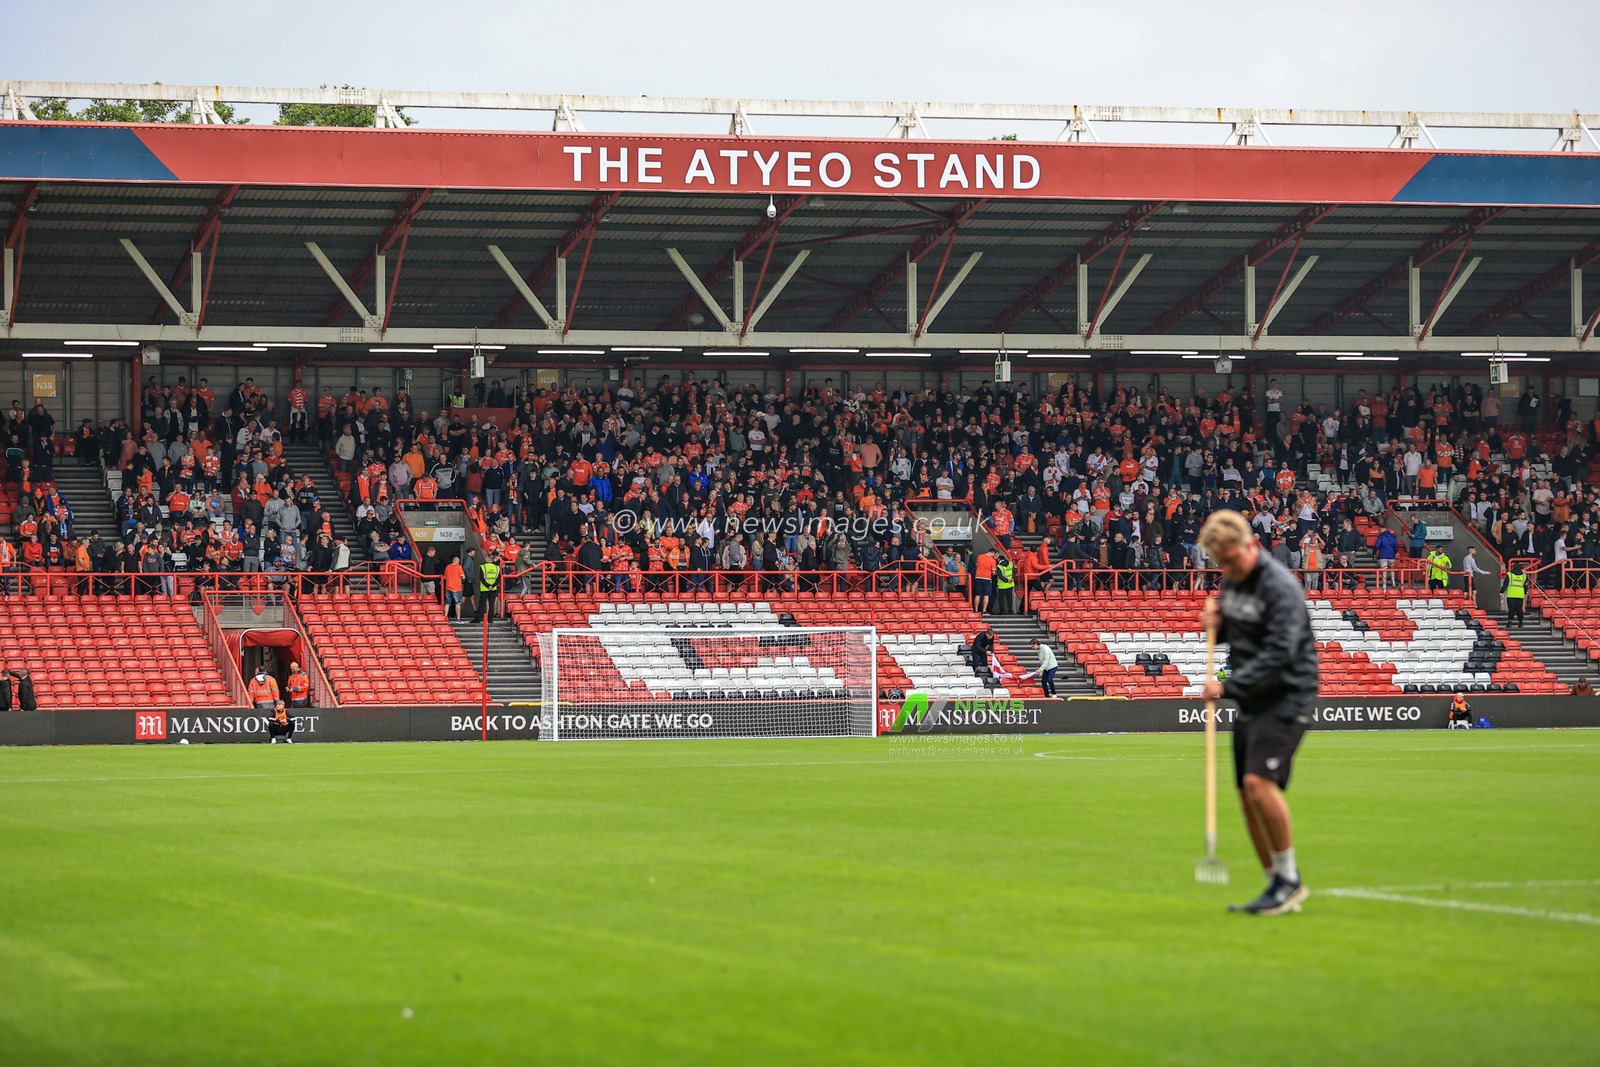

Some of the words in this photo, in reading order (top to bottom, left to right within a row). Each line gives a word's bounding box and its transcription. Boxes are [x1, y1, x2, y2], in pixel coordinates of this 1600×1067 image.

[562, 145, 663, 184] THE
[684, 148, 852, 189] ATYEO
[873, 153, 1041, 191] STAND
[36, 382, 53, 390] N39
[540, 376, 556, 384] N38
[451, 715, 499, 731] BACK
[501, 715, 527, 731] TO
[529, 714, 603, 731] ASHTON
[607, 713, 652, 730] GATE
[654, 713, 682, 729] WE
[686, 713, 714, 729] GO
[904, 708, 1042, 726] MANSIONBET
[1178, 708, 1223, 723] BACK
[1225, 708, 1239, 723] T
[1322, 706, 1364, 722] GATE
[1366, 706, 1393, 722] WE
[1396, 706, 1421, 721] GO
[170, 715, 320, 734] MANSIONET
